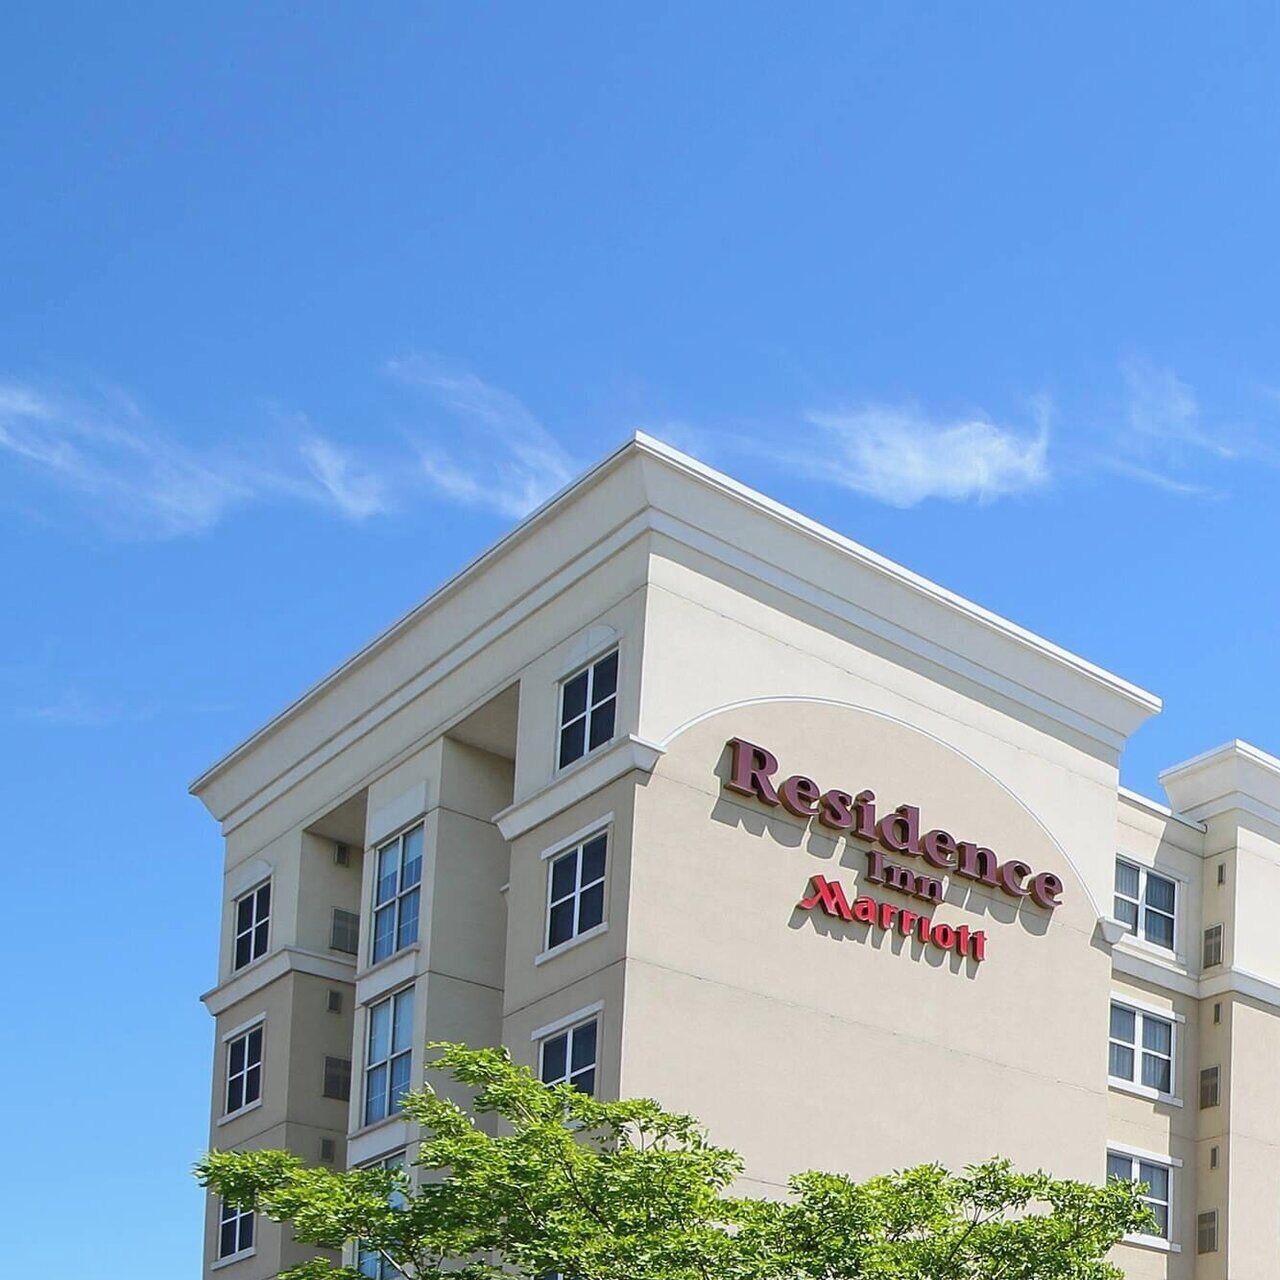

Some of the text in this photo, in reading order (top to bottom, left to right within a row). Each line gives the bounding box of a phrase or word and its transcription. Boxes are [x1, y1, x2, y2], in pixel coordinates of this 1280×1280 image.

[726, 736, 1064, 910] Residence
[799, 874, 989, 963] Marriott
[865, 849, 944, 905] Inn
